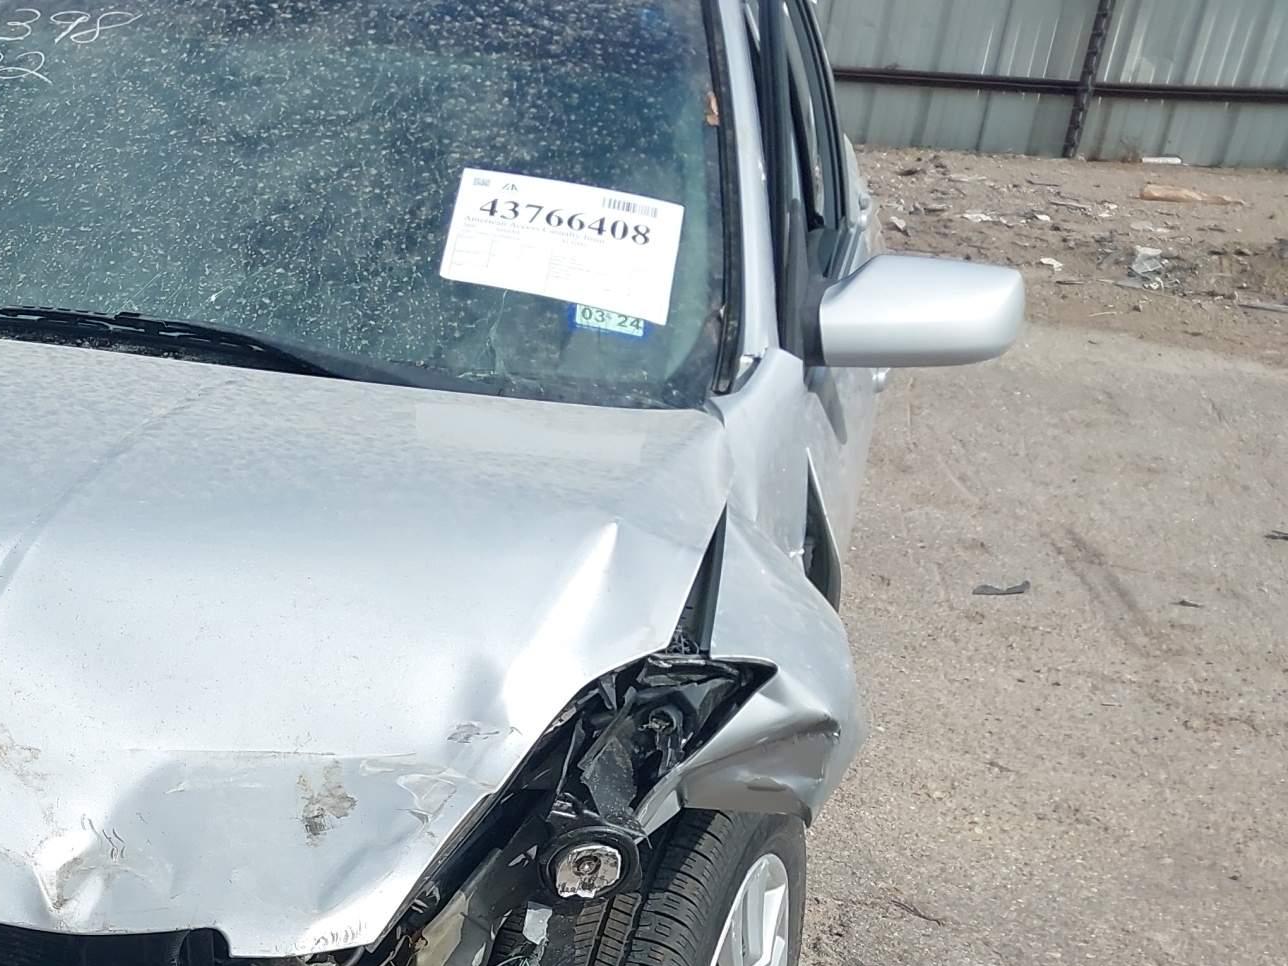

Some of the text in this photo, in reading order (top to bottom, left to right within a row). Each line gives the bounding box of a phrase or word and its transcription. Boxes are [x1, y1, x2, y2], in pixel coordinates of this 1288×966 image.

[479, 198, 651, 246] 43766408
[580, 307, 642, 331] 03 24
